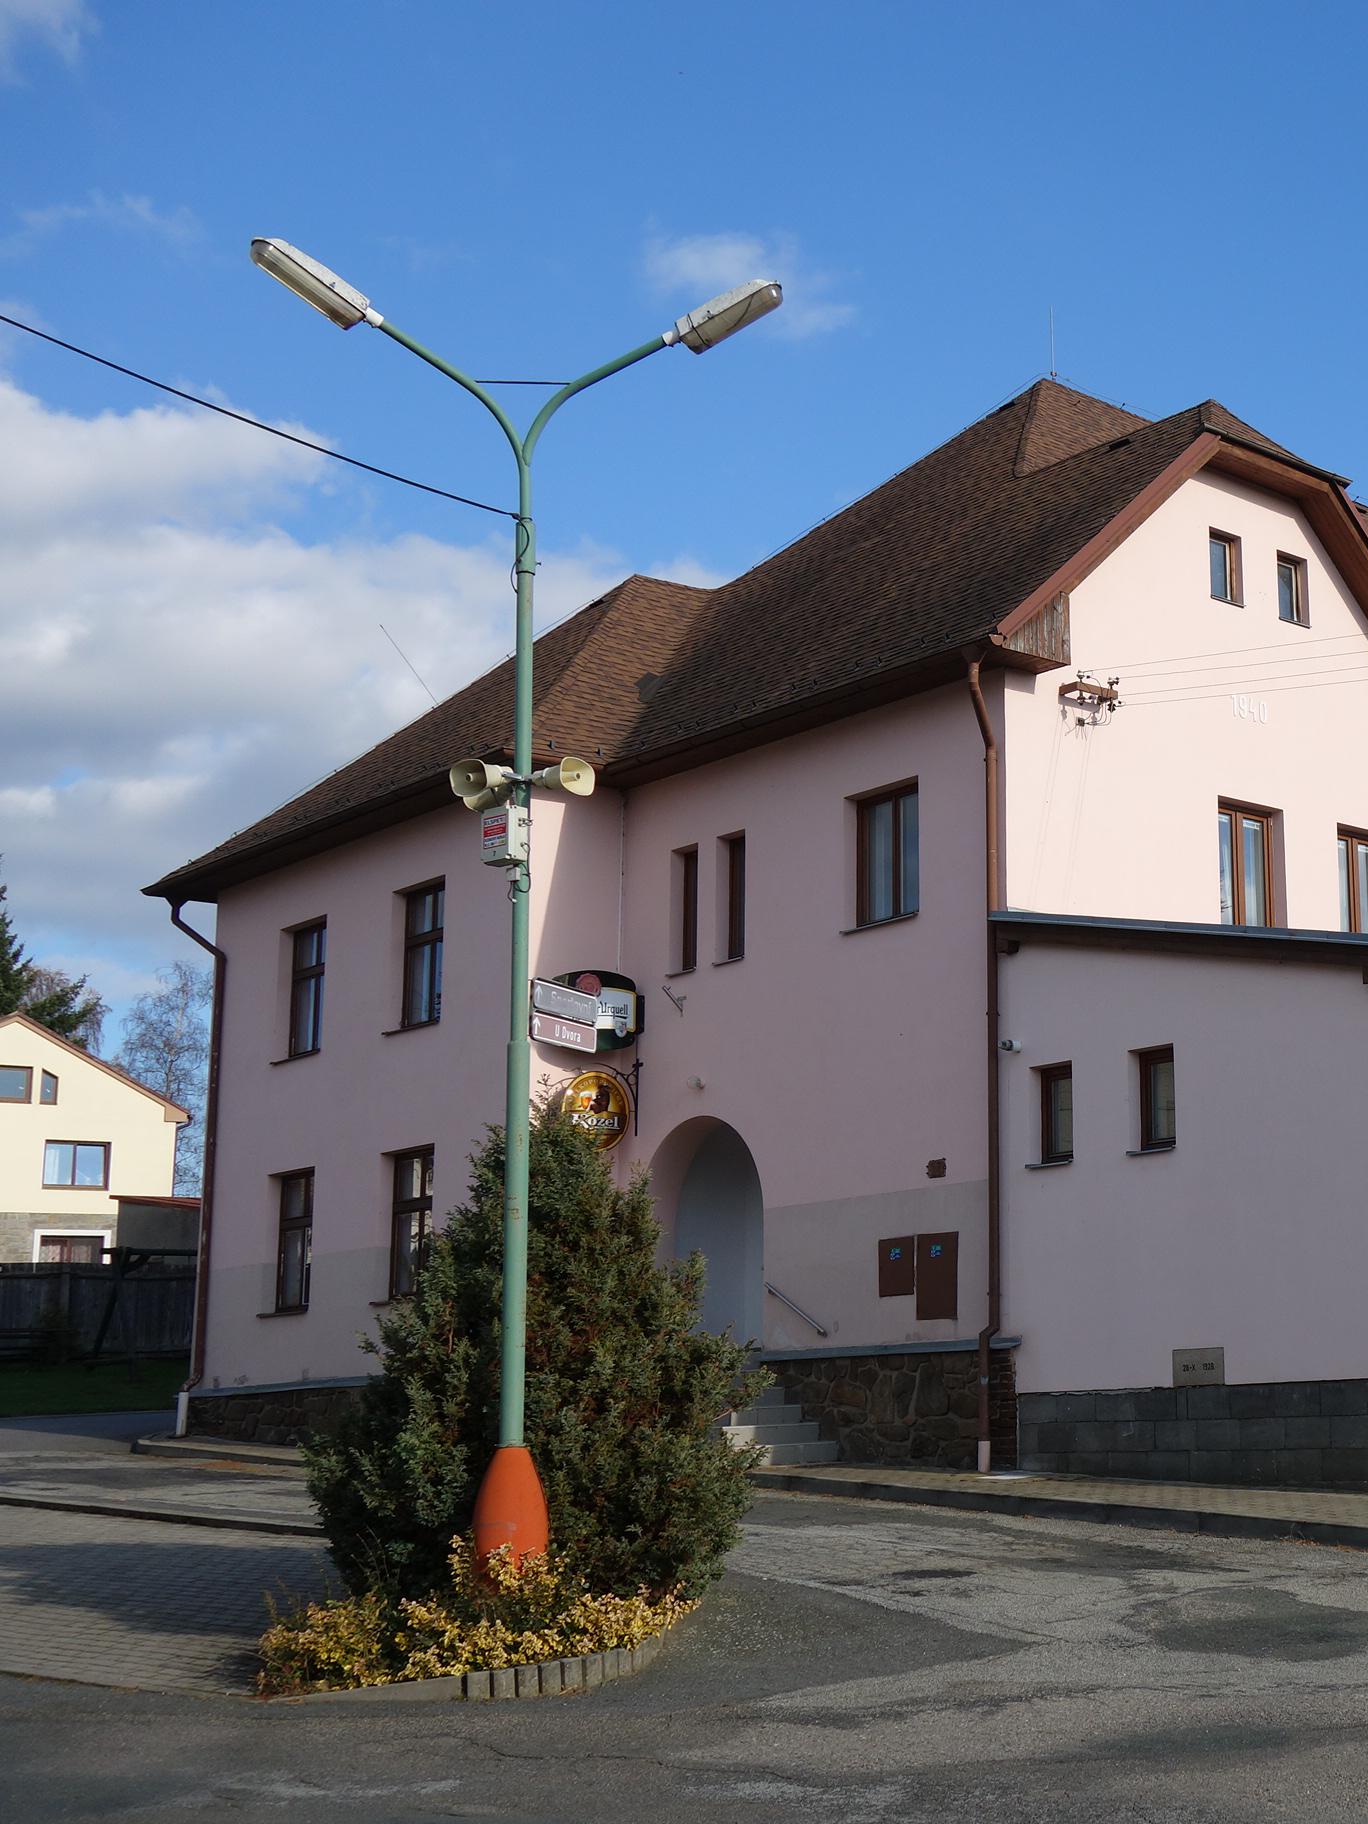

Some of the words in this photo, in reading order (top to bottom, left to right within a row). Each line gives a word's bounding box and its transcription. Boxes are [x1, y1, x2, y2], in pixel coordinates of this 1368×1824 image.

[1231, 695, 1268, 726] 1940
[550, 991, 593, 1017] Stovní
[599, 1001, 628, 1019] Urquell
[555, 1023, 560, 1037] U
[562, 1026, 582, 1042] Dvora
[571, 1113, 620, 1129] Kozel
